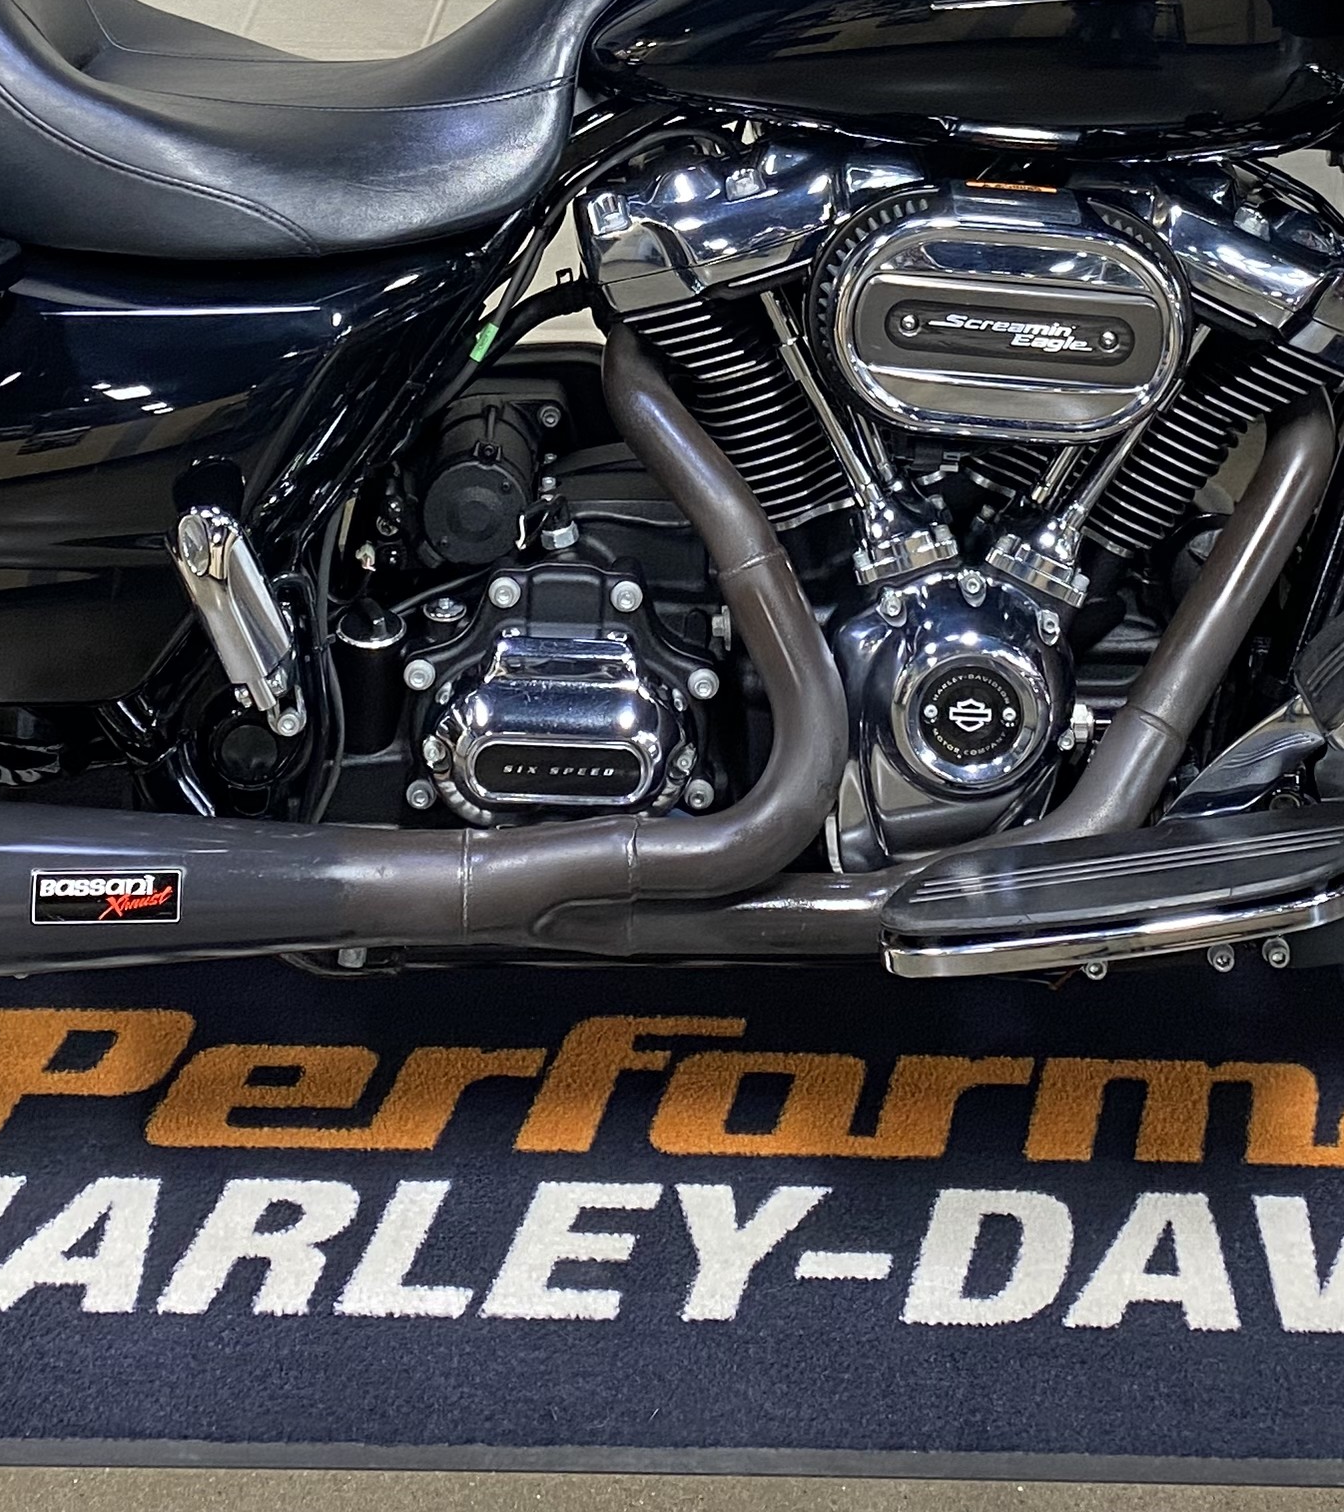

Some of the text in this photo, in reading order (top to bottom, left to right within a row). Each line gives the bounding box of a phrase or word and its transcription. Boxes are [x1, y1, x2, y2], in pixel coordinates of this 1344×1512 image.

[1011, 333, 1093, 352] Eagle
[932, 673, 1011, 705] HARLEY-DAVIDSON
[932, 728, 1006, 756] MOTOR COMPANY
[503, 765, 614, 777] SIX SPEED
[99, 885, 173, 920] Xhaust
